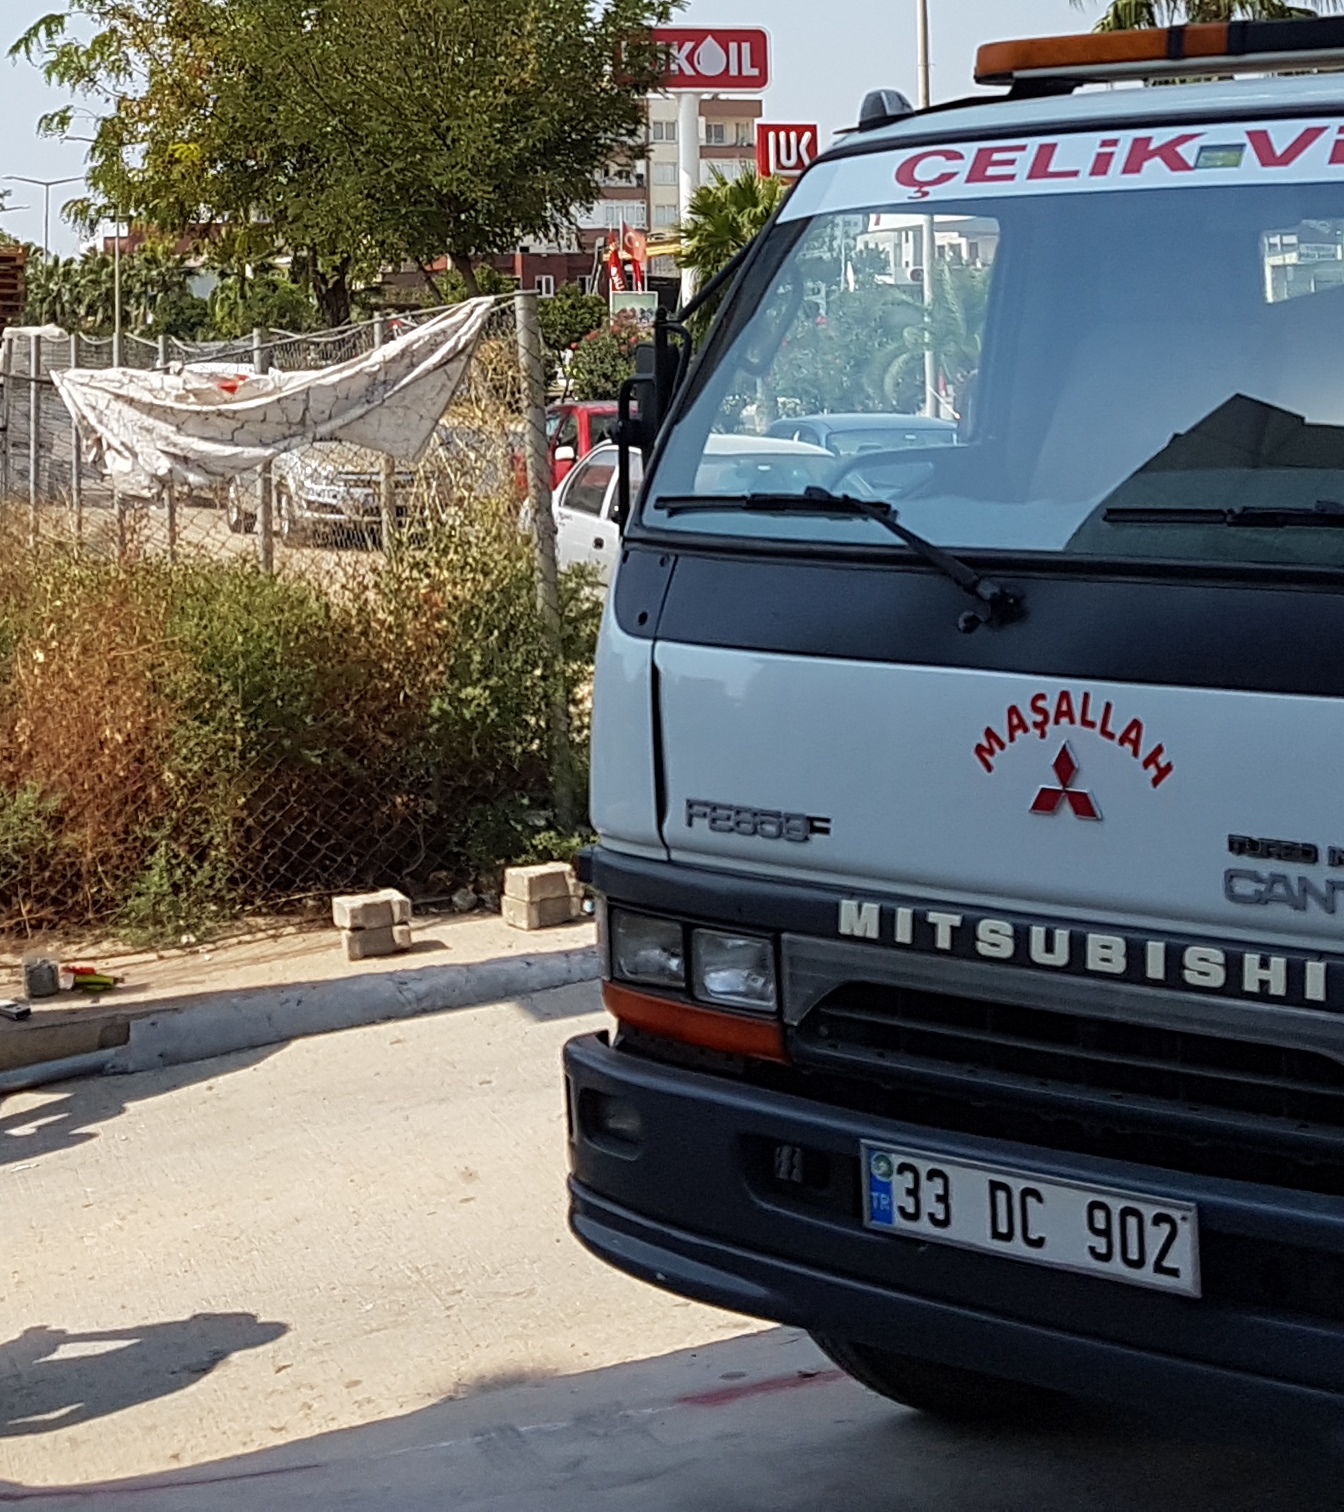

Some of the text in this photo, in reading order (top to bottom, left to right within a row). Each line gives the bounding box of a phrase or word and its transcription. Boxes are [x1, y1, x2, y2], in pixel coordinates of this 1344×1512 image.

[973, 690, 1176, 788] MAŞALLAH
[1228, 834, 1319, 864] TURBO
[839, 899, 1328, 1001] MITSUBISHI
[871, 1192, 891, 1211] TR
[896, 1161, 1181, 1279] 33 DC 902
